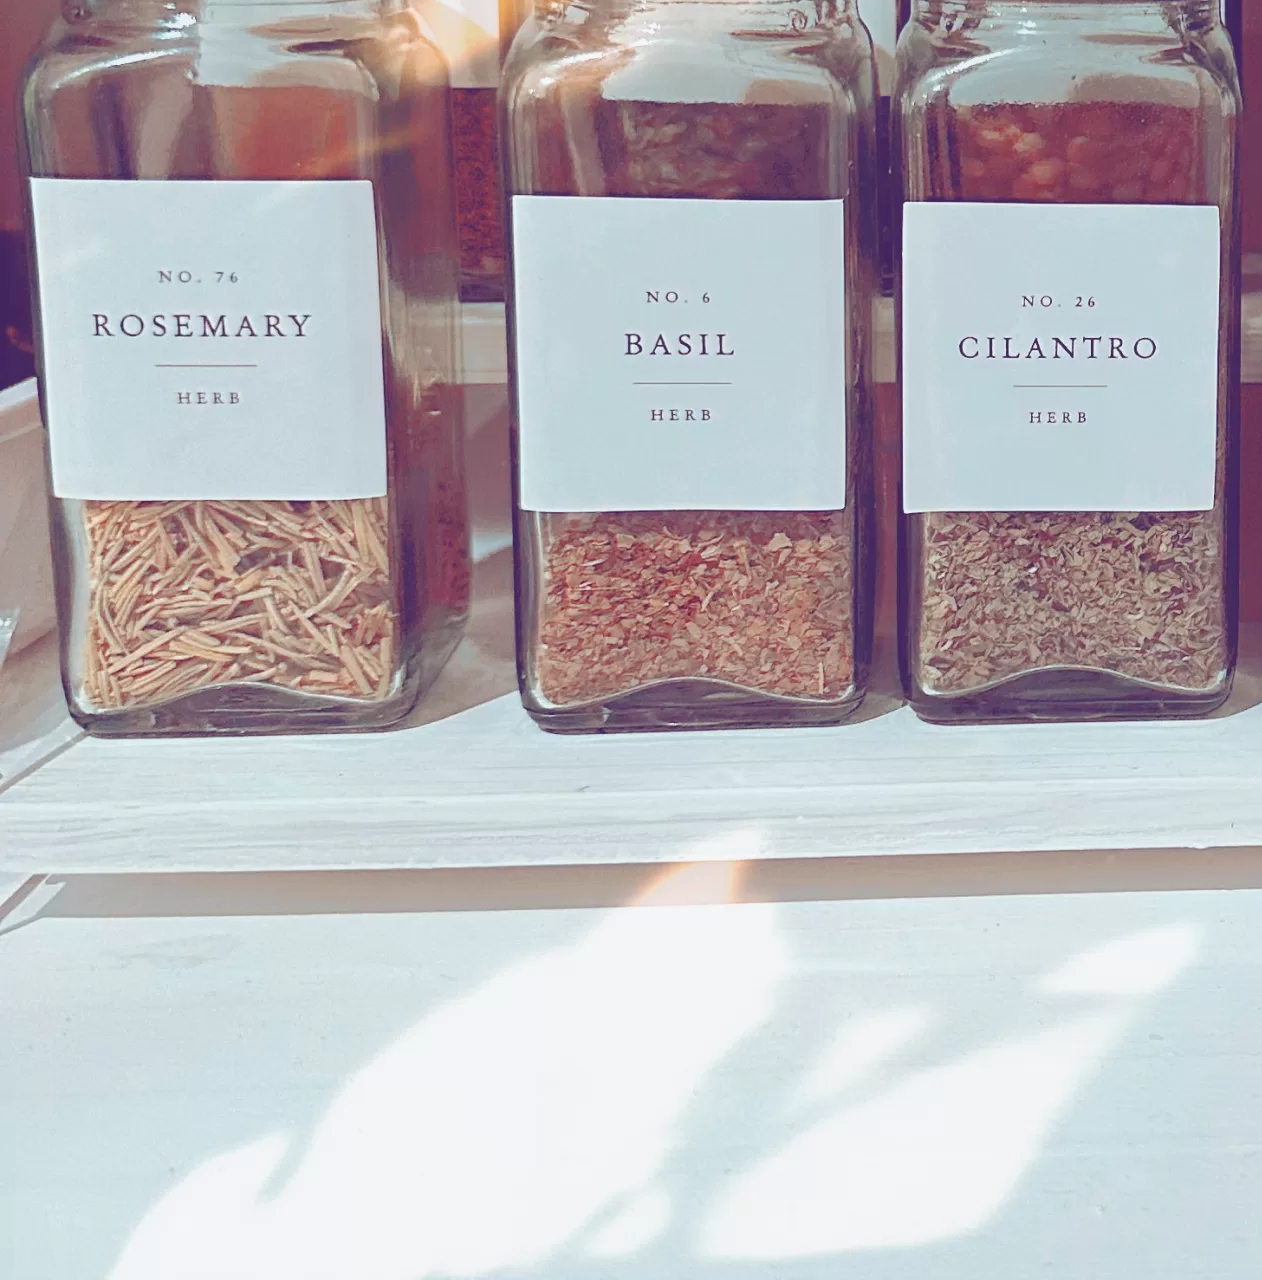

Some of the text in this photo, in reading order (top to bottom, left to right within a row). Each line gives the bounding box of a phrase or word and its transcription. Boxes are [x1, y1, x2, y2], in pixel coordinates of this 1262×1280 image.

[156, 270, 239, 284] NO. 76
[645, 290, 711, 304] NO. 6
[1021, 294, 1096, 308] NO. 26
[91, 313, 313, 338] ROSEMARY
[623, 332, 735, 356] BASIL
[958, 335, 1157, 360] CILANTRO
[176, 391, 240, 405] HERB
[649, 408, 712, 422] HERB
[1028, 411, 1087, 424] HERB
